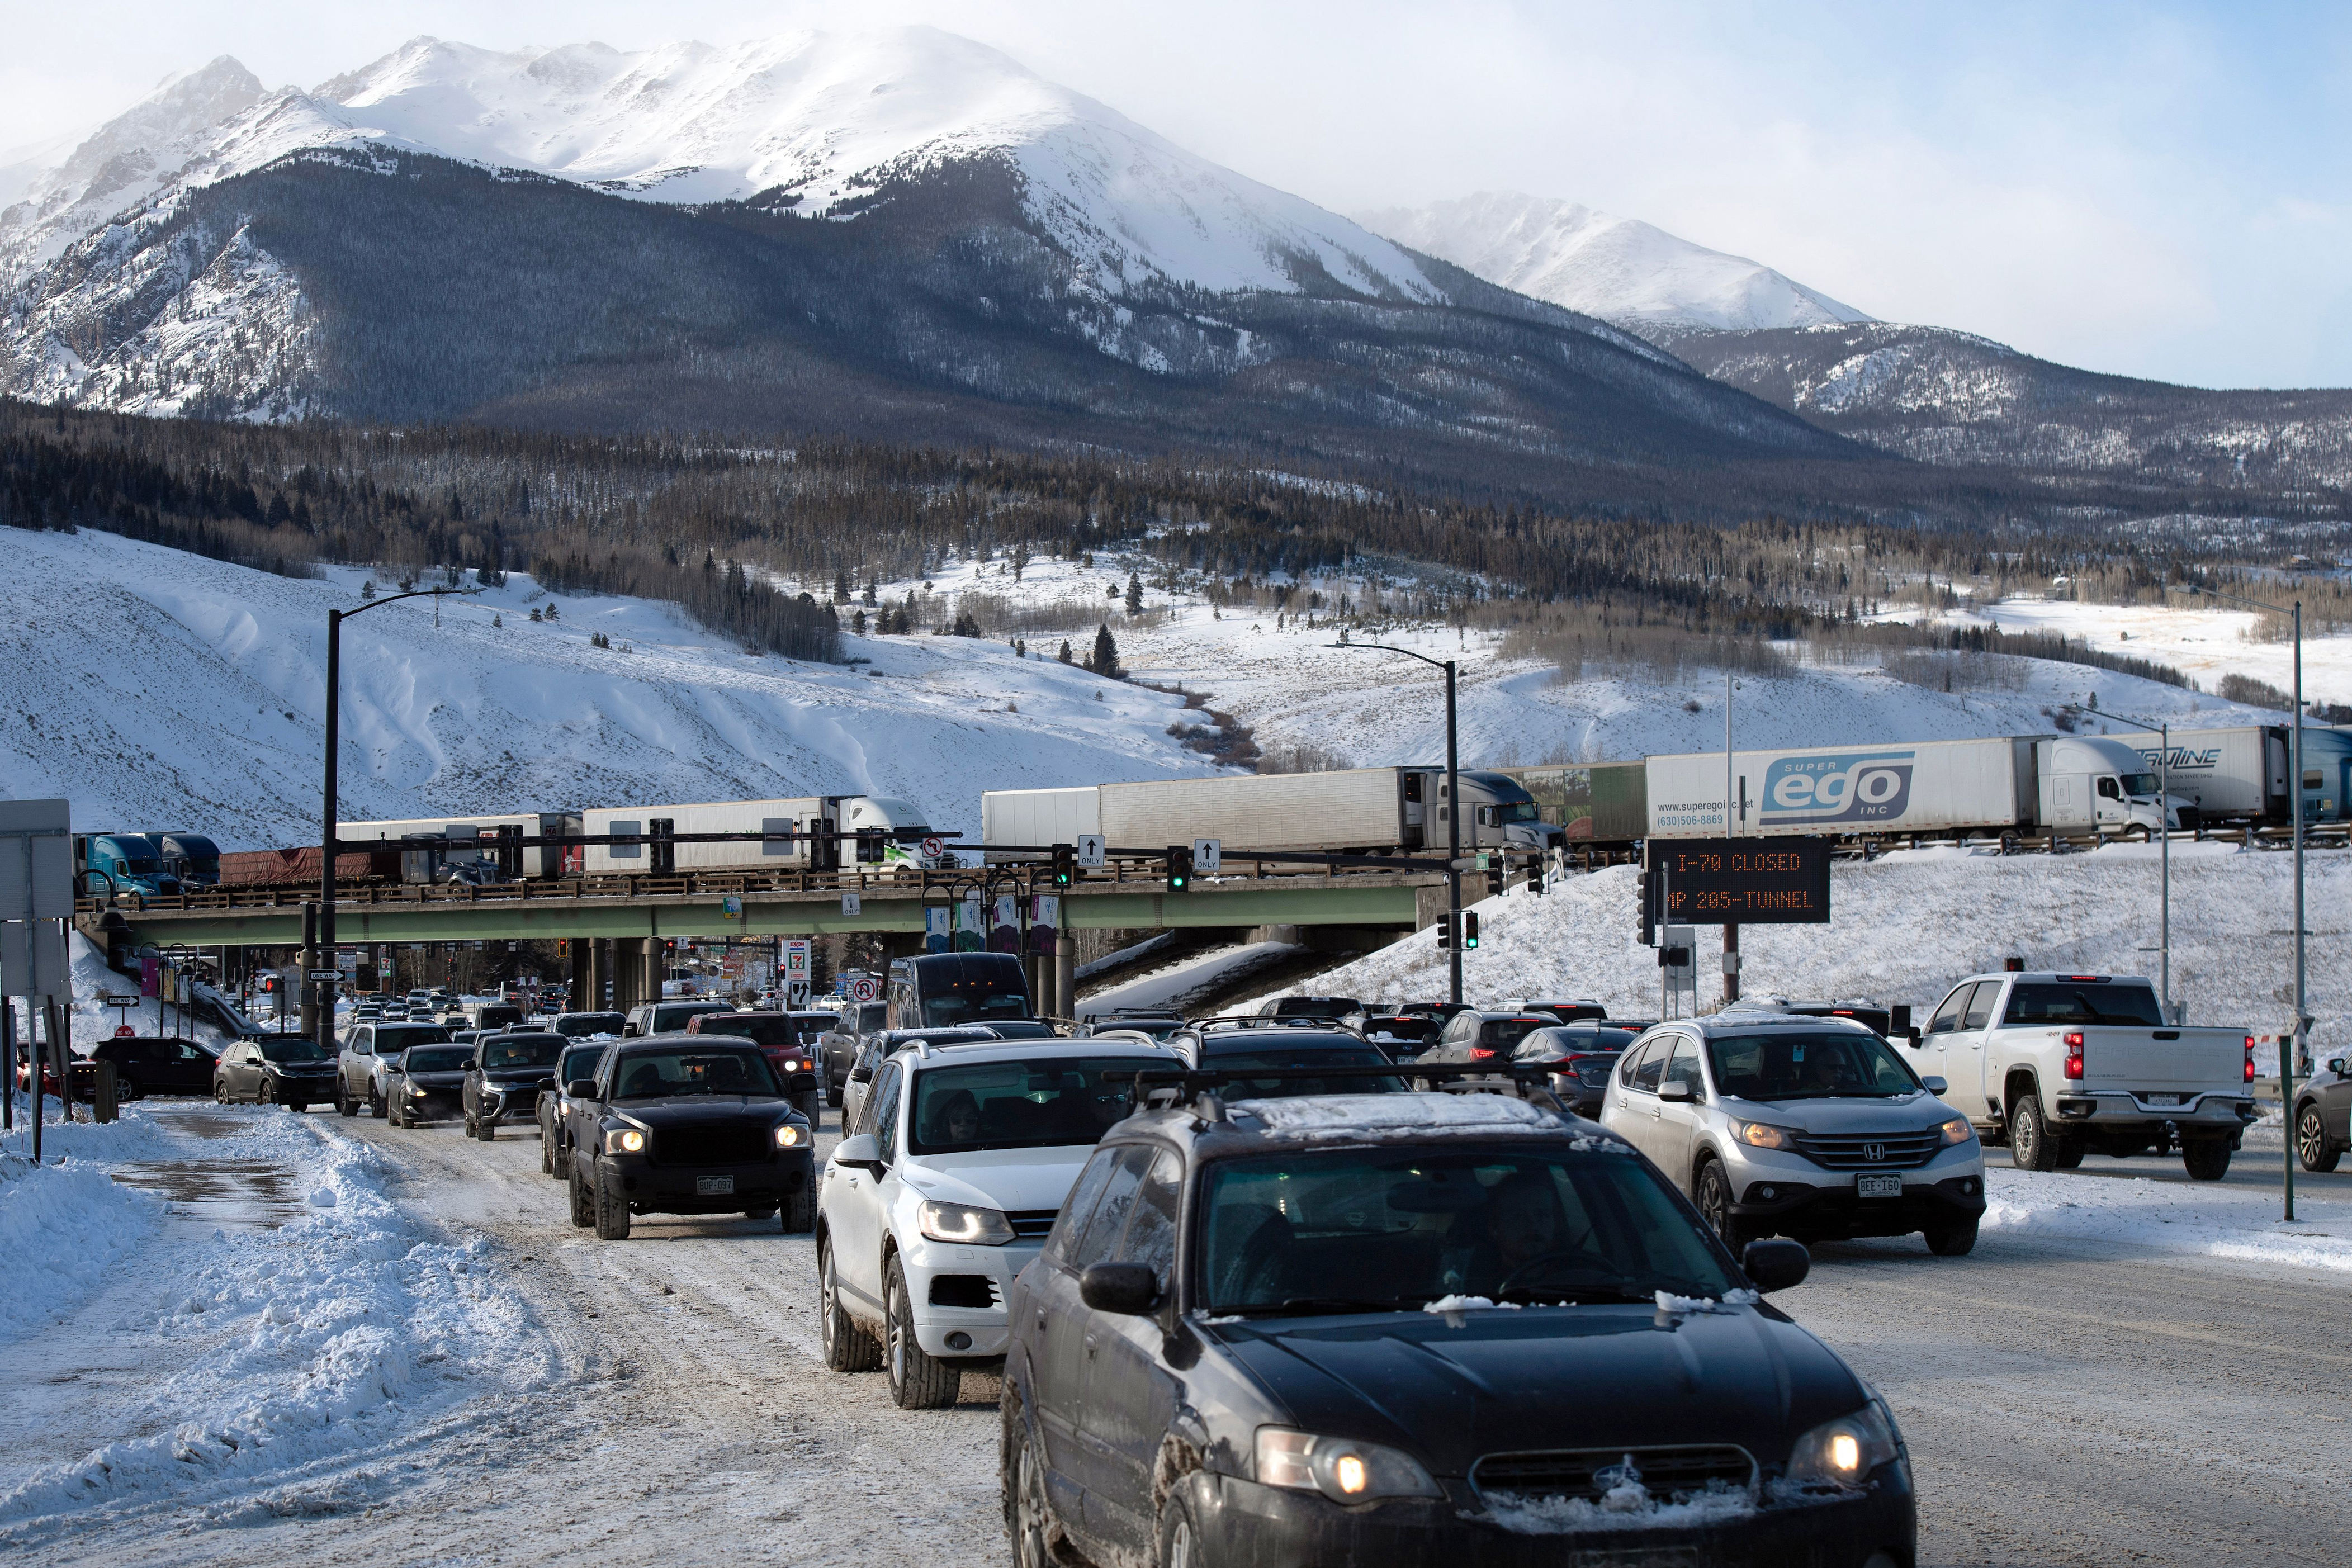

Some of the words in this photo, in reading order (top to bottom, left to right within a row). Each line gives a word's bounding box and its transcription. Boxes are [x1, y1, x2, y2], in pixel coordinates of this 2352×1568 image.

[1785, 762, 1836, 772] SUPER
[1773, 769, 1901, 811] ego
[1658, 799, 1754, 813] www.superegoic.et
[1860, 806, 1887, 815] INC
[1657, 814, 1722, 828] (630)506-8869
[1678, 854, 1721, 871] I-70
[1732, 854, 1800, 871] CLOSED
[1697, 890, 1814, 909] 205-TUNNEL
[2094, 1045, 2235, 1058] CHEVROLET
